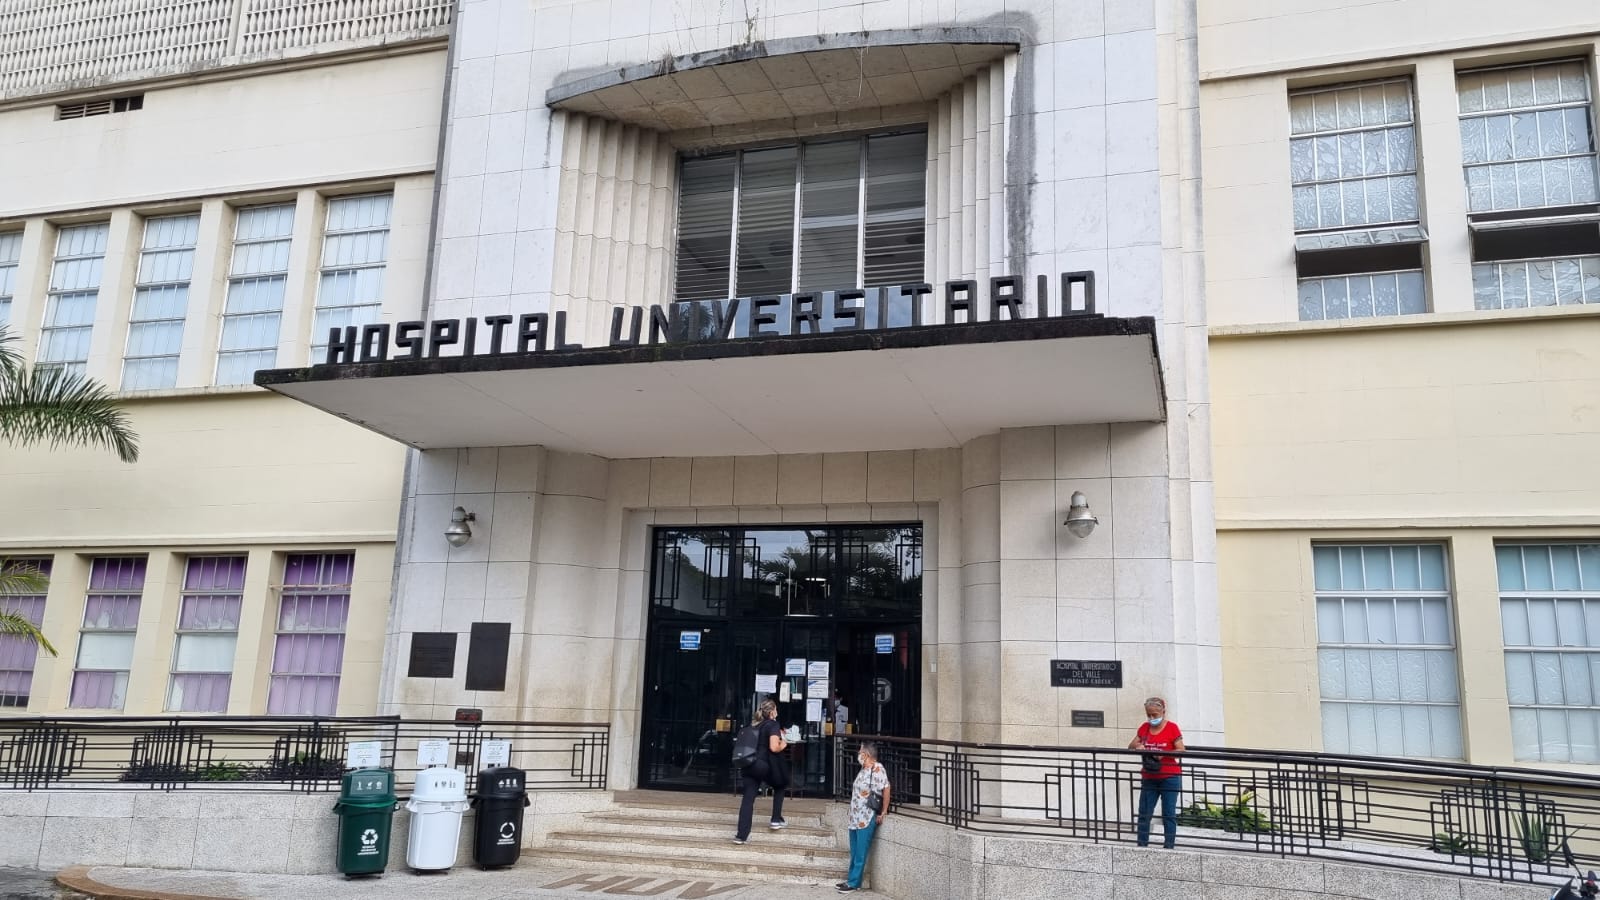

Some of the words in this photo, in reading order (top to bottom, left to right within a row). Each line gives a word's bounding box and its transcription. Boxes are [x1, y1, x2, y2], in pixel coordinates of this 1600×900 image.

[326, 310, 583, 365] HOSPITAL
[610, 270, 1096, 346] UNIVERSITARIO
[1072, 670, 1084, 678] DEL
[538, 873, 751, 900] HUV
